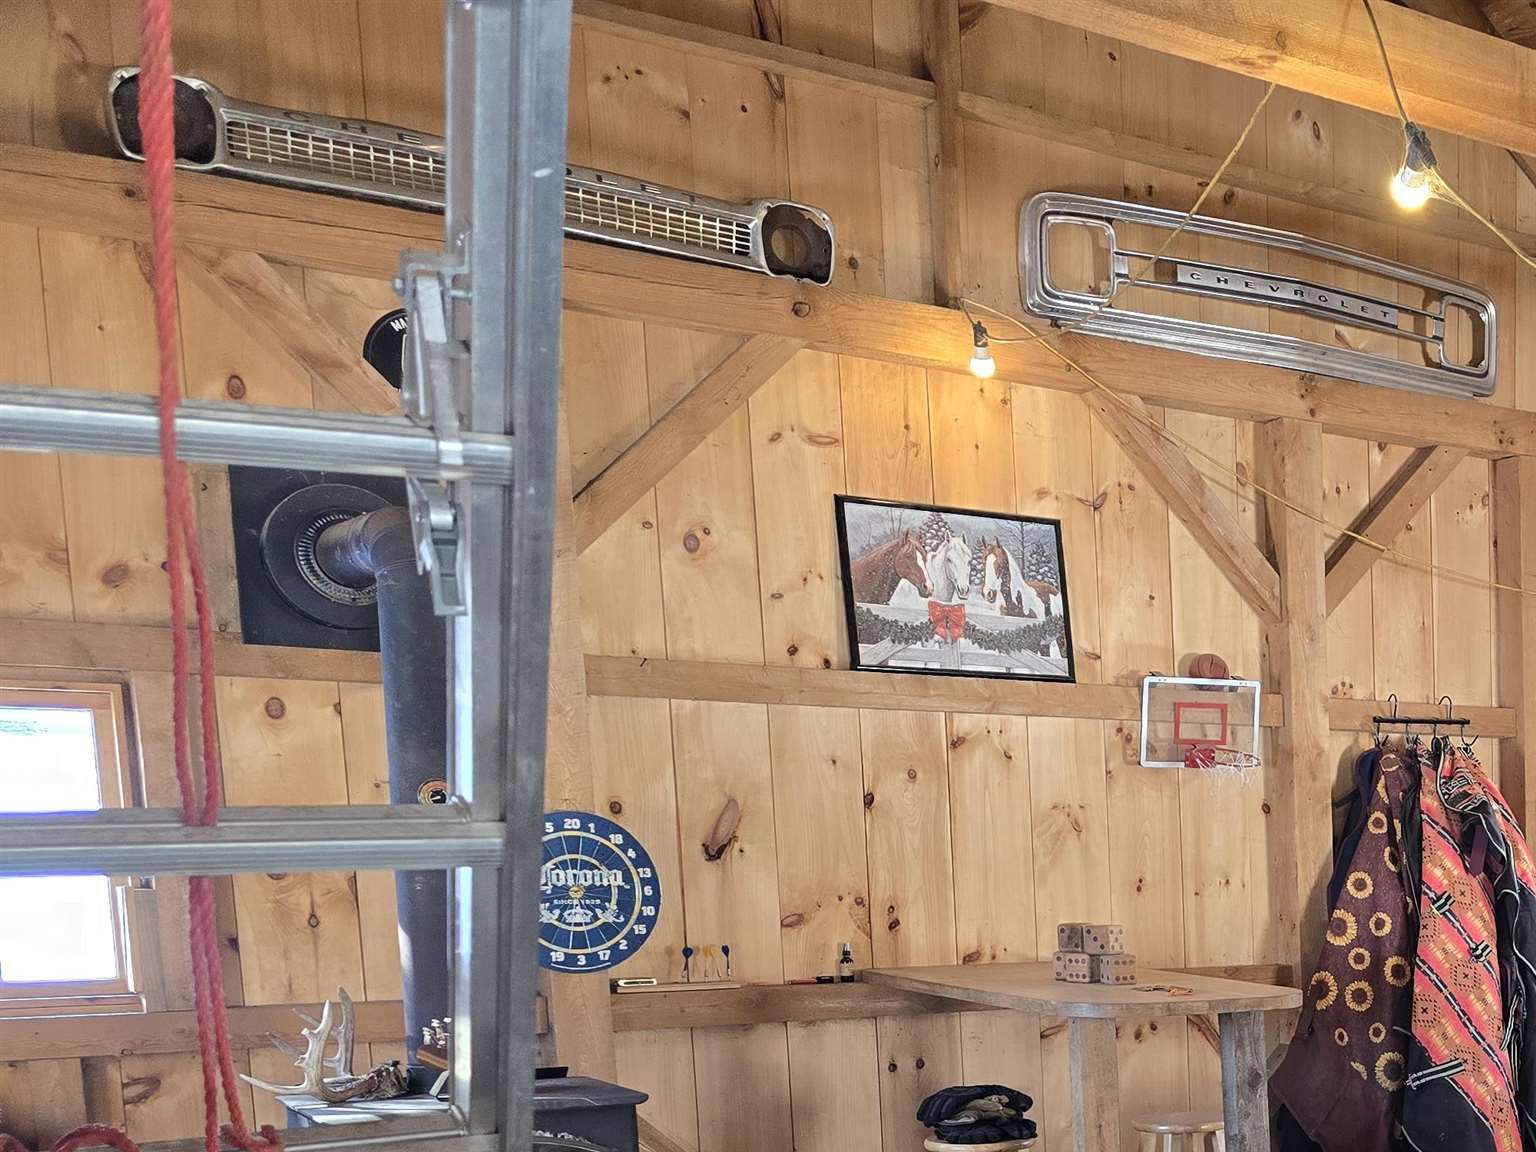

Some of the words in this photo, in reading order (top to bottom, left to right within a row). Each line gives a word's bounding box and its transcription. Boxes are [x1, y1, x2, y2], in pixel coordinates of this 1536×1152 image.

[283, 111, 702, 203] CHELET
[1189, 272, 1390, 318] CHEVROLET
[544, 822, 554, 833] 5
[563, 818, 581, 829] 20
[588, 823, 596, 833] 1
[608, 834, 623, 844] 18
[627, 848, 636, 859] 4
[637, 867, 652, 878] 13
[540, 864, 630, 895] Corona
[643, 886, 653, 896] 6
[641, 906, 655, 916] 10
[633, 924, 647, 935] 15
[619, 939, 628, 950] 2
[550, 951, 565, 962] 19
[577, 954, 586, 965] 3
[597, 950, 611, 960] 17
